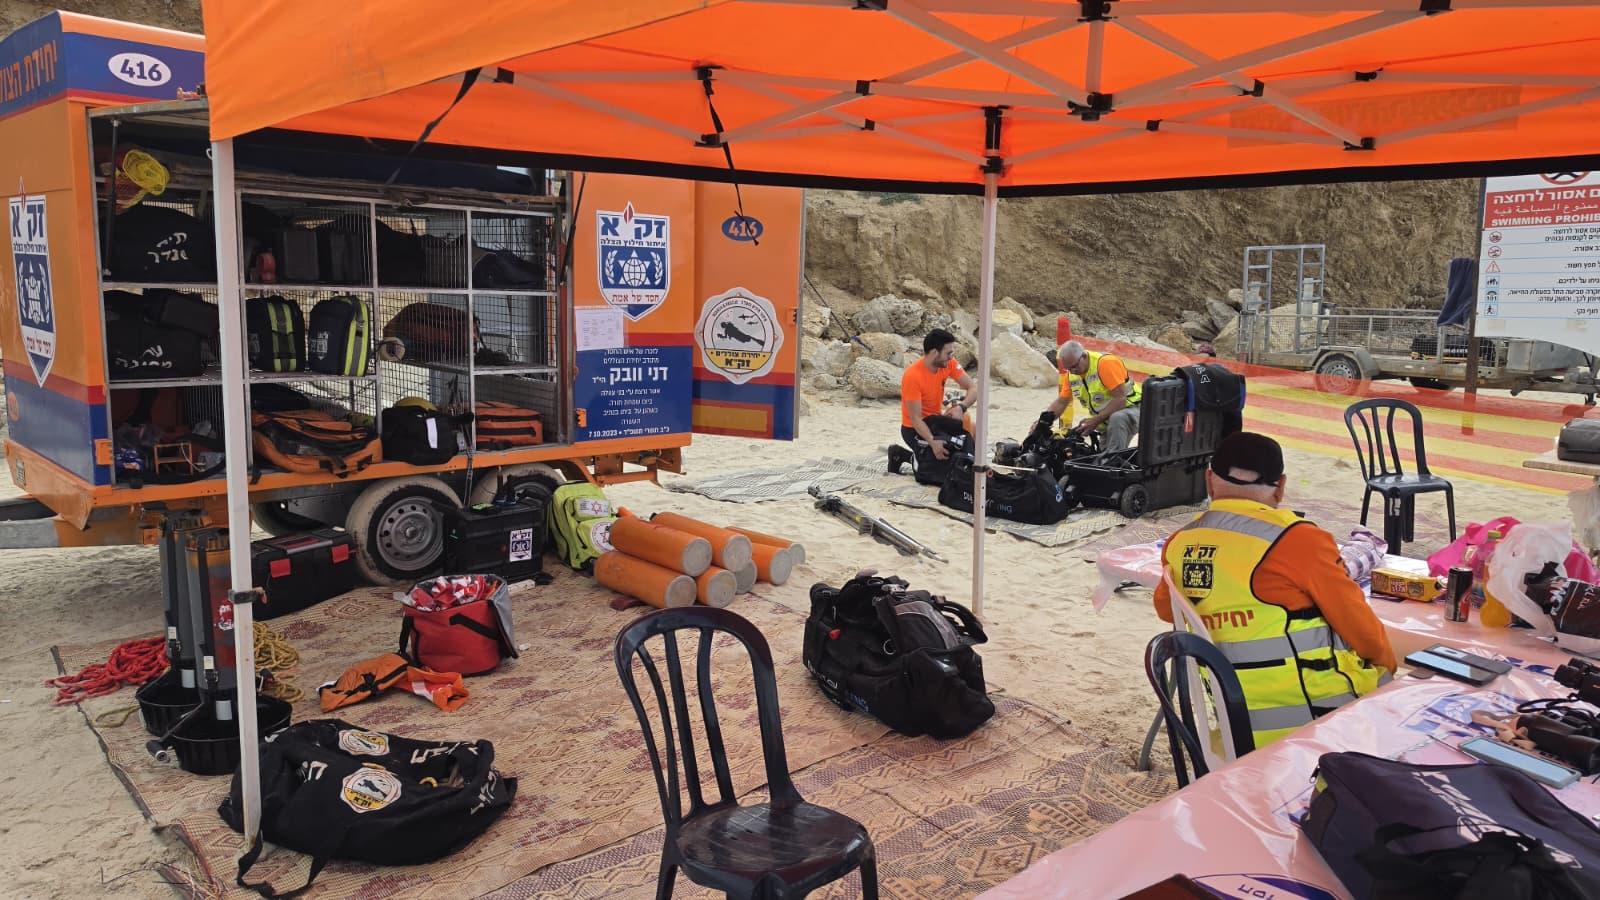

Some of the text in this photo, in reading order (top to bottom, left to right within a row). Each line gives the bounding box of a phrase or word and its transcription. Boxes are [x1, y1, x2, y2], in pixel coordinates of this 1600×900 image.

[23, 39, 58, 92] יחידת
[120, 59, 163, 82] 416
[1493, 189, 1545, 205] לרחצה
[1547, 189, 1586, 201] אסור
[1493, 202, 1598, 217] ممنوع السباحة فيه
[728, 219, 758, 237] 416
[1491, 215, 1552, 227] SWIMMING
[600, 237, 666, 248] איתור חילוץ הצלה
[611, 293, 629, 303] אמת
[645, 294, 660, 303] חסד
[742, 351, 761, 359] יחידת
[725, 358, 751, 369] זק"א
[609, 366, 643, 386] וובק
[647, 366, 669, 382] דני
[1184, 545, 1217, 560] זק"א
